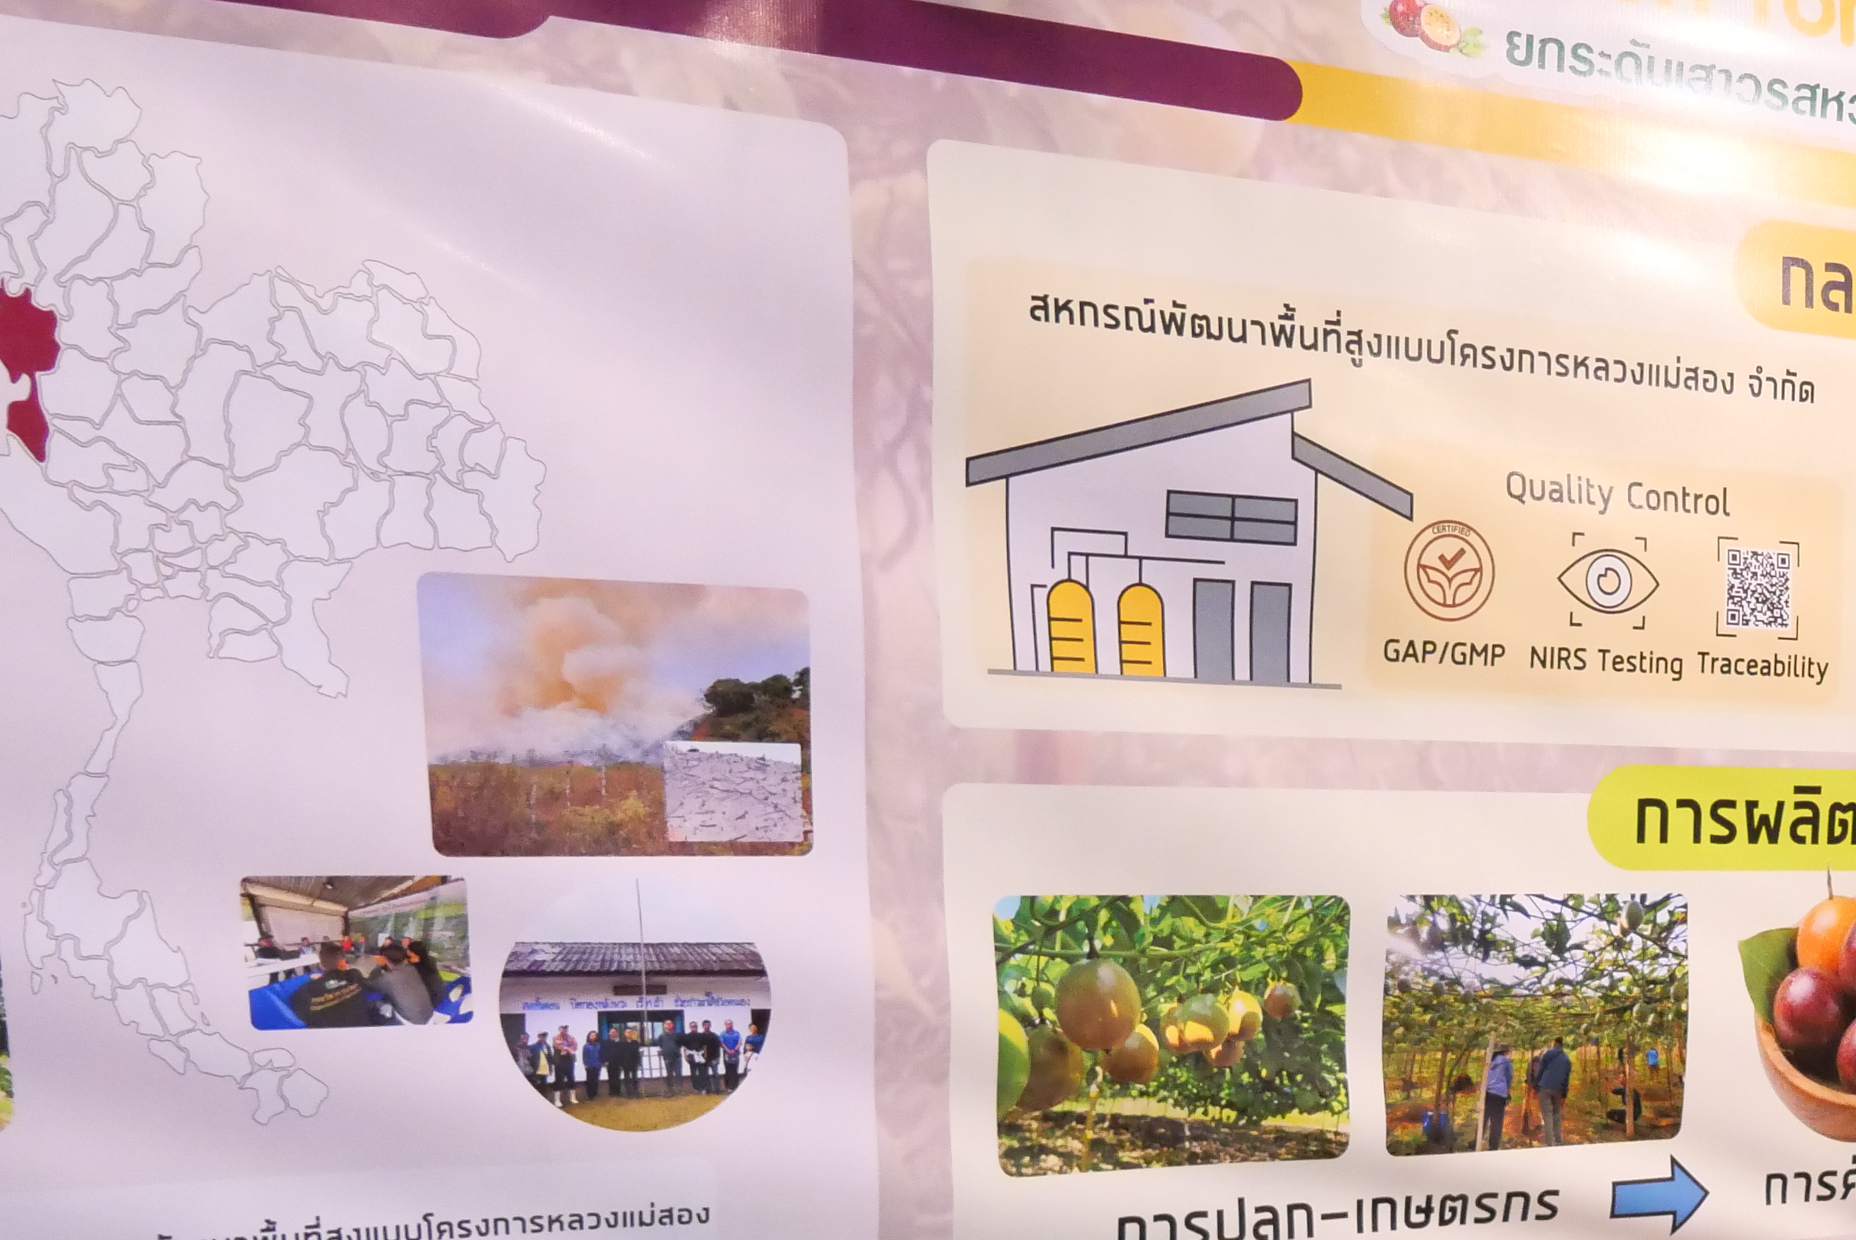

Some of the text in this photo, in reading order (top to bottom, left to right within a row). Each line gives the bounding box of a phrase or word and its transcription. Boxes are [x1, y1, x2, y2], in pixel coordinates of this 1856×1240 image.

[1029, 291, 1817, 405] สหกรณ์พัฒนาพื้นที่สูงแบบโครงการหลวงแม่สอง จำกัด
[1505, 470, 1732, 518] Quality Control
[1431, 524, 1471, 537] CERTIFIED
[1383, 637, 1506, 668] GAP/GMP
[1529, 645, 1685, 681] NIRS Testing
[1697, 651, 1829, 685] Traceability
